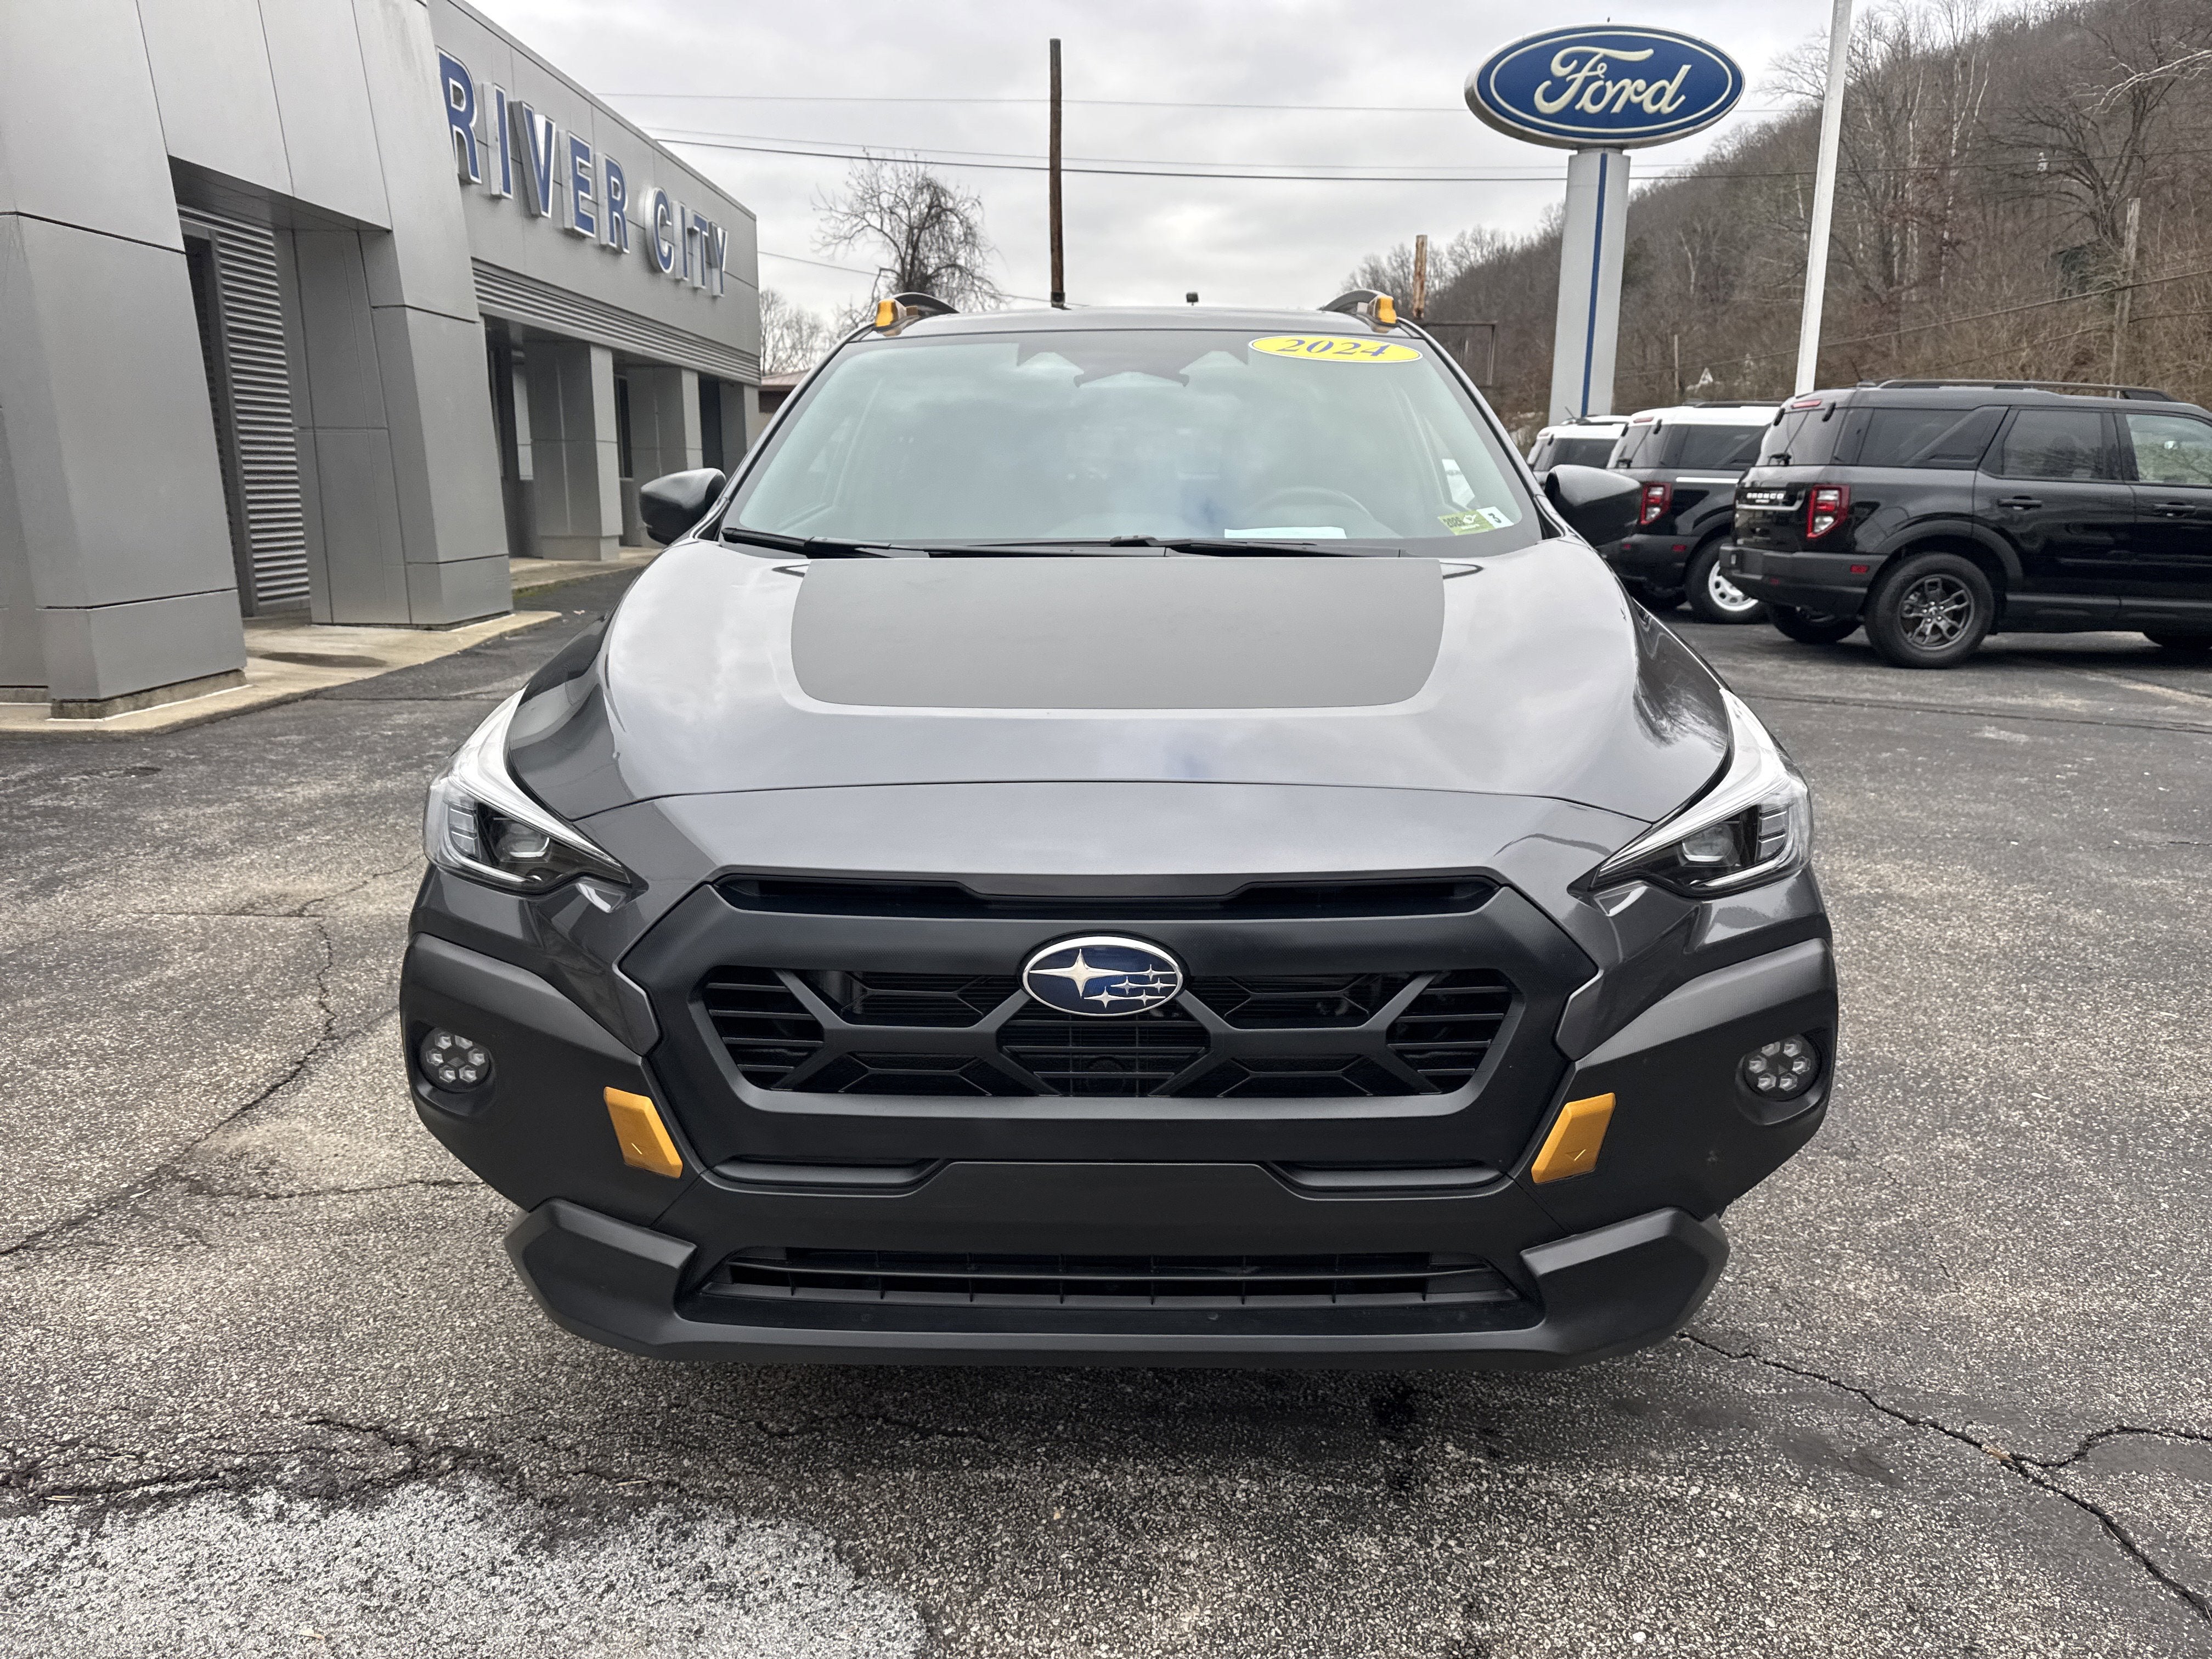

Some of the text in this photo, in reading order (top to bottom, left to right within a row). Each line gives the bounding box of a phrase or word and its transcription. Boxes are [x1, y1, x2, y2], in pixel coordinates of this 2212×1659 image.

[1534, 46, 1691, 114] Ford
[438, 48, 727, 297] RIVER CITY
[1276, 338, 1391, 357] 2024
[1487, 512, 1502, 523] 3
